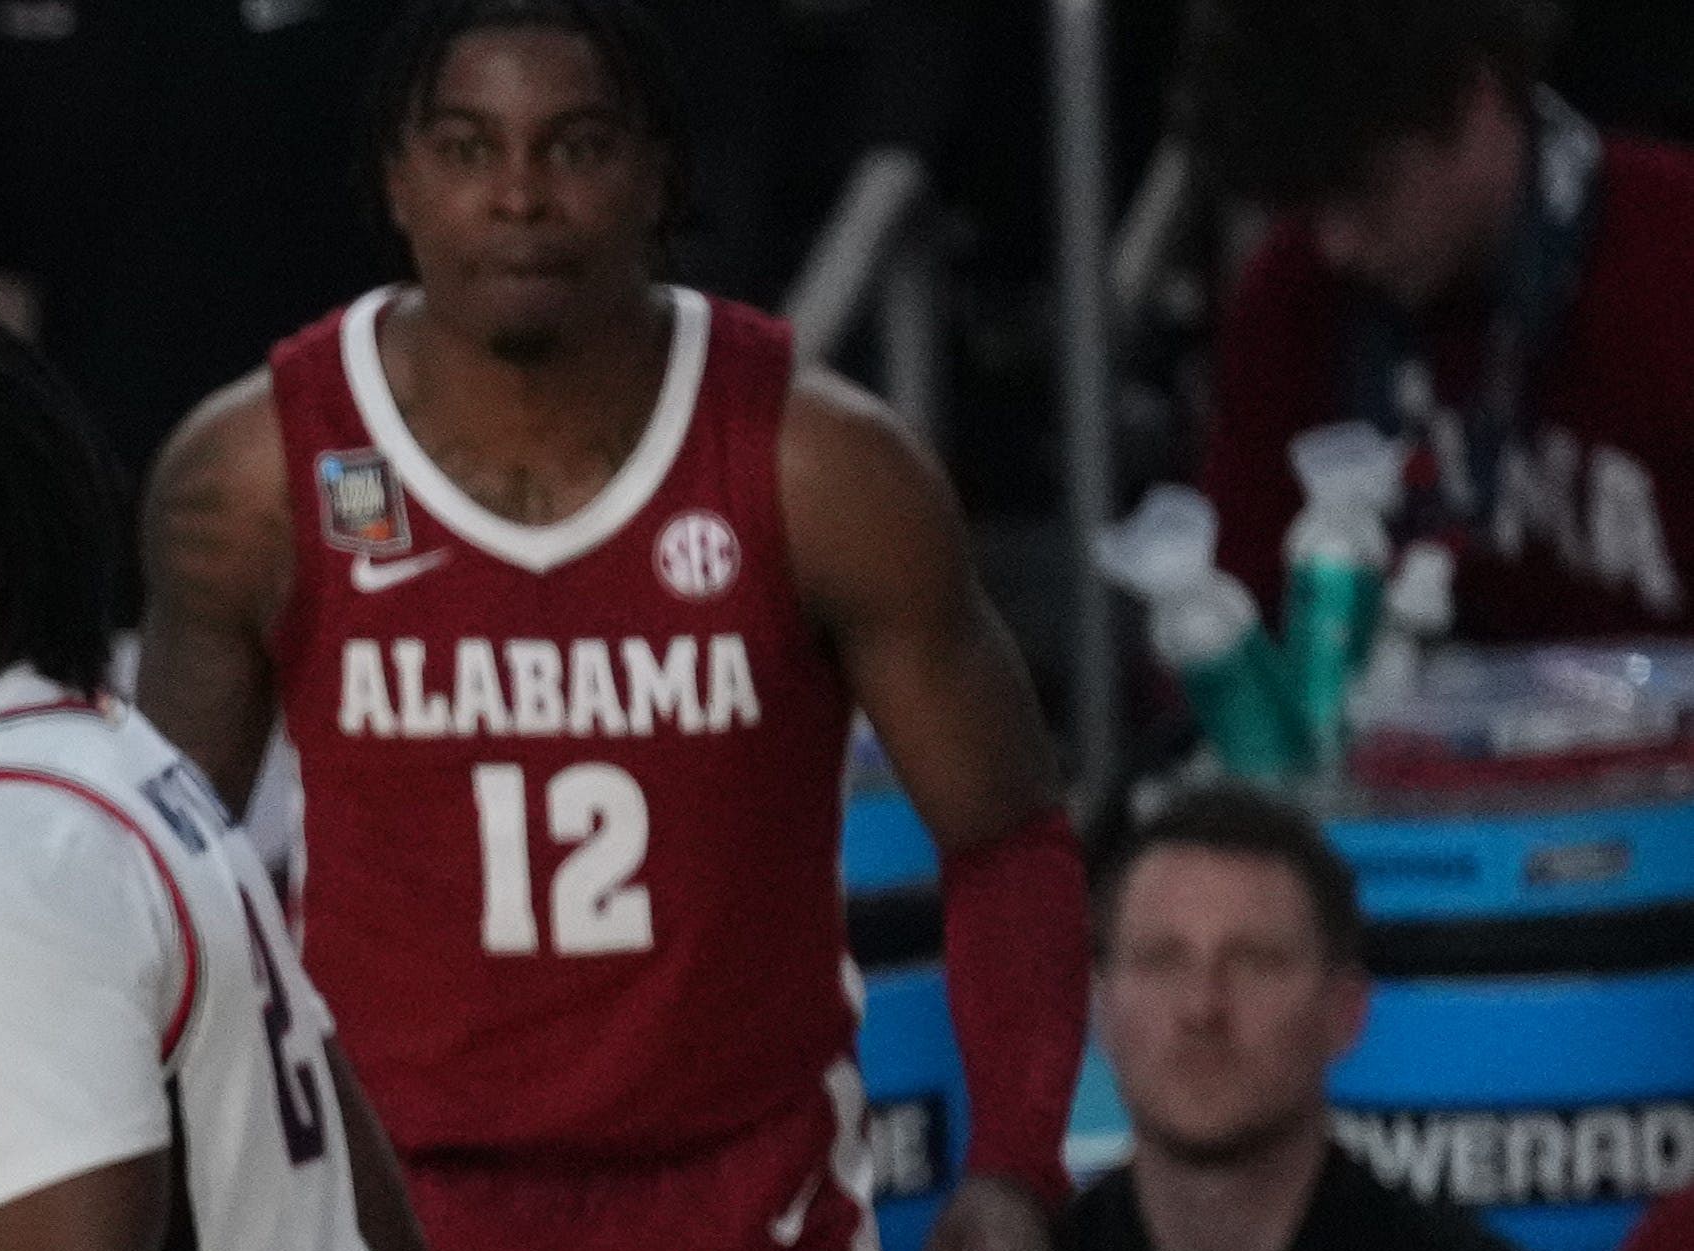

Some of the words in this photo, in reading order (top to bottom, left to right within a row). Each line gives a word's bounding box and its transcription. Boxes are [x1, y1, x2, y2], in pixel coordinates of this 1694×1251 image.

[658, 514, 734, 596] SEC
[338, 632, 762, 739] ALABAMA
[472, 762, 655, 957] 12
